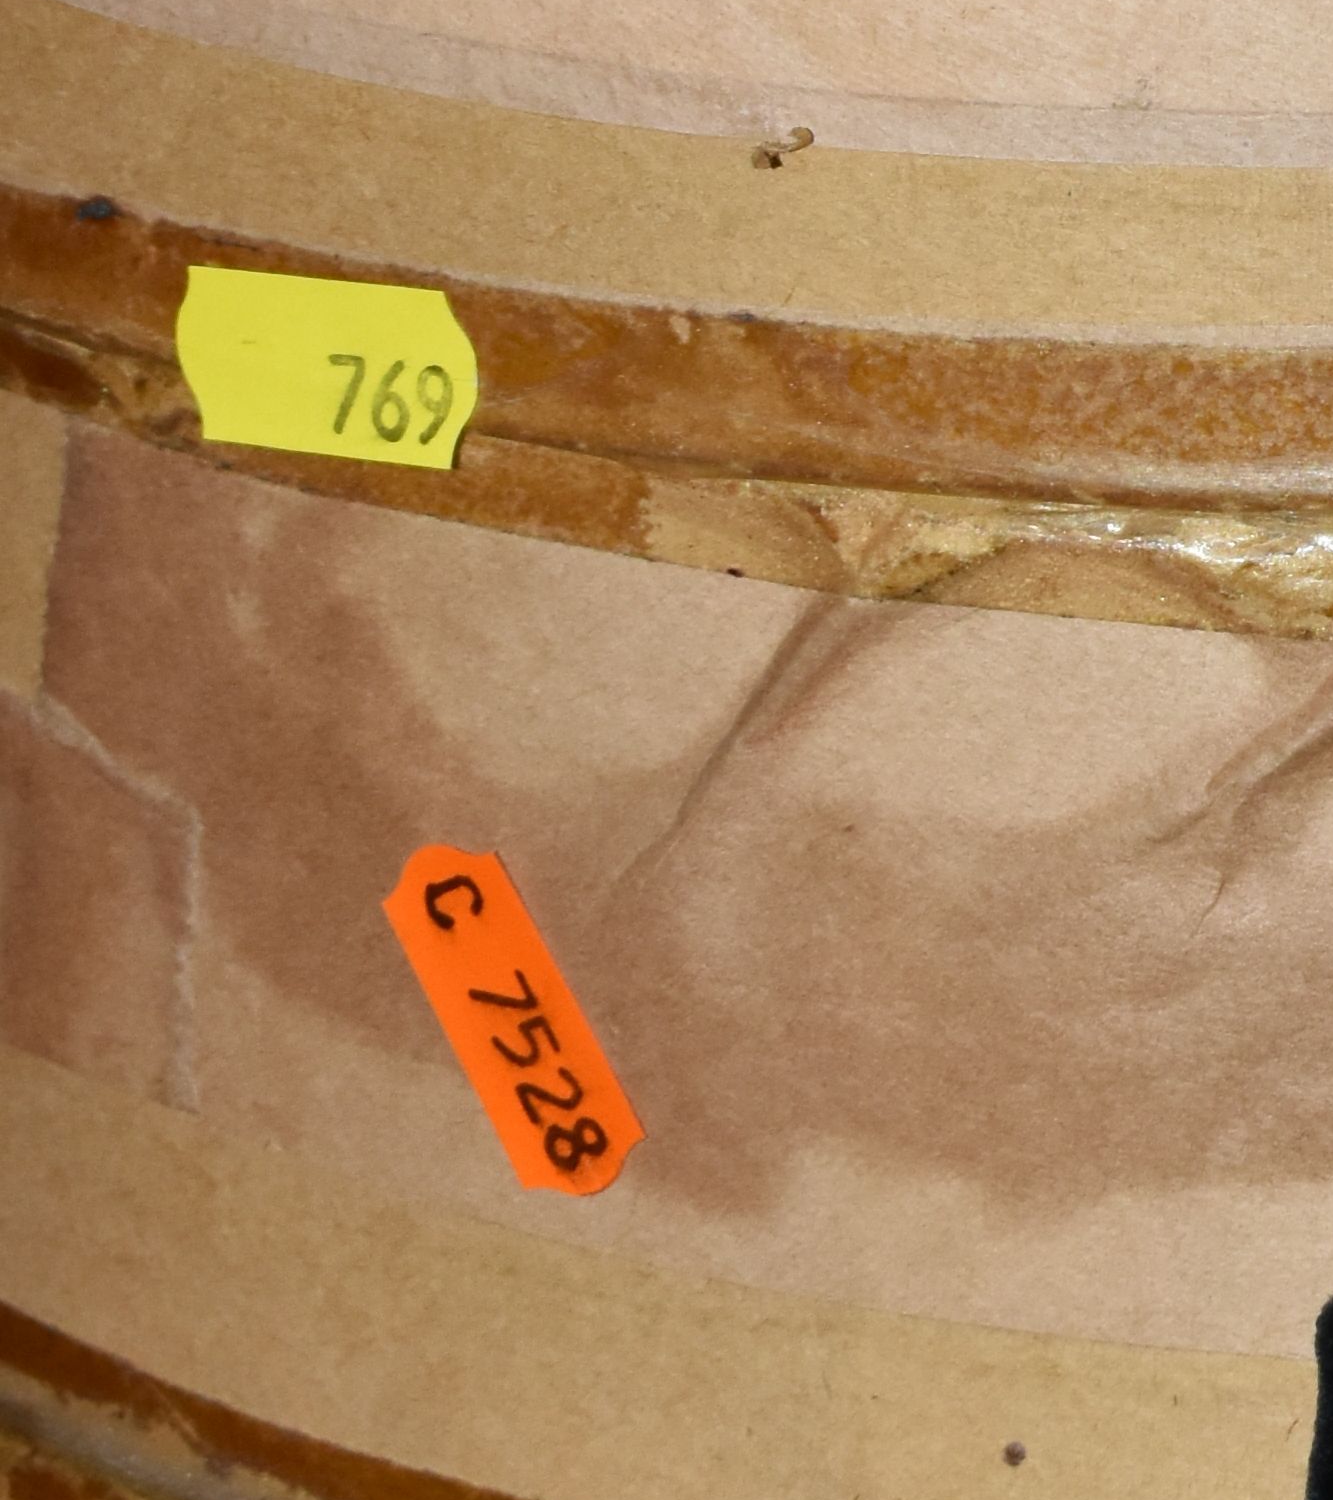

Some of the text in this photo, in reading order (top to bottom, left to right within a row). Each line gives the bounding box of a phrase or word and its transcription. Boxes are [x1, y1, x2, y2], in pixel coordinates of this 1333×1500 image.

[325, 353, 455, 446] 769
[424, 876, 608, 1175] C 7528
